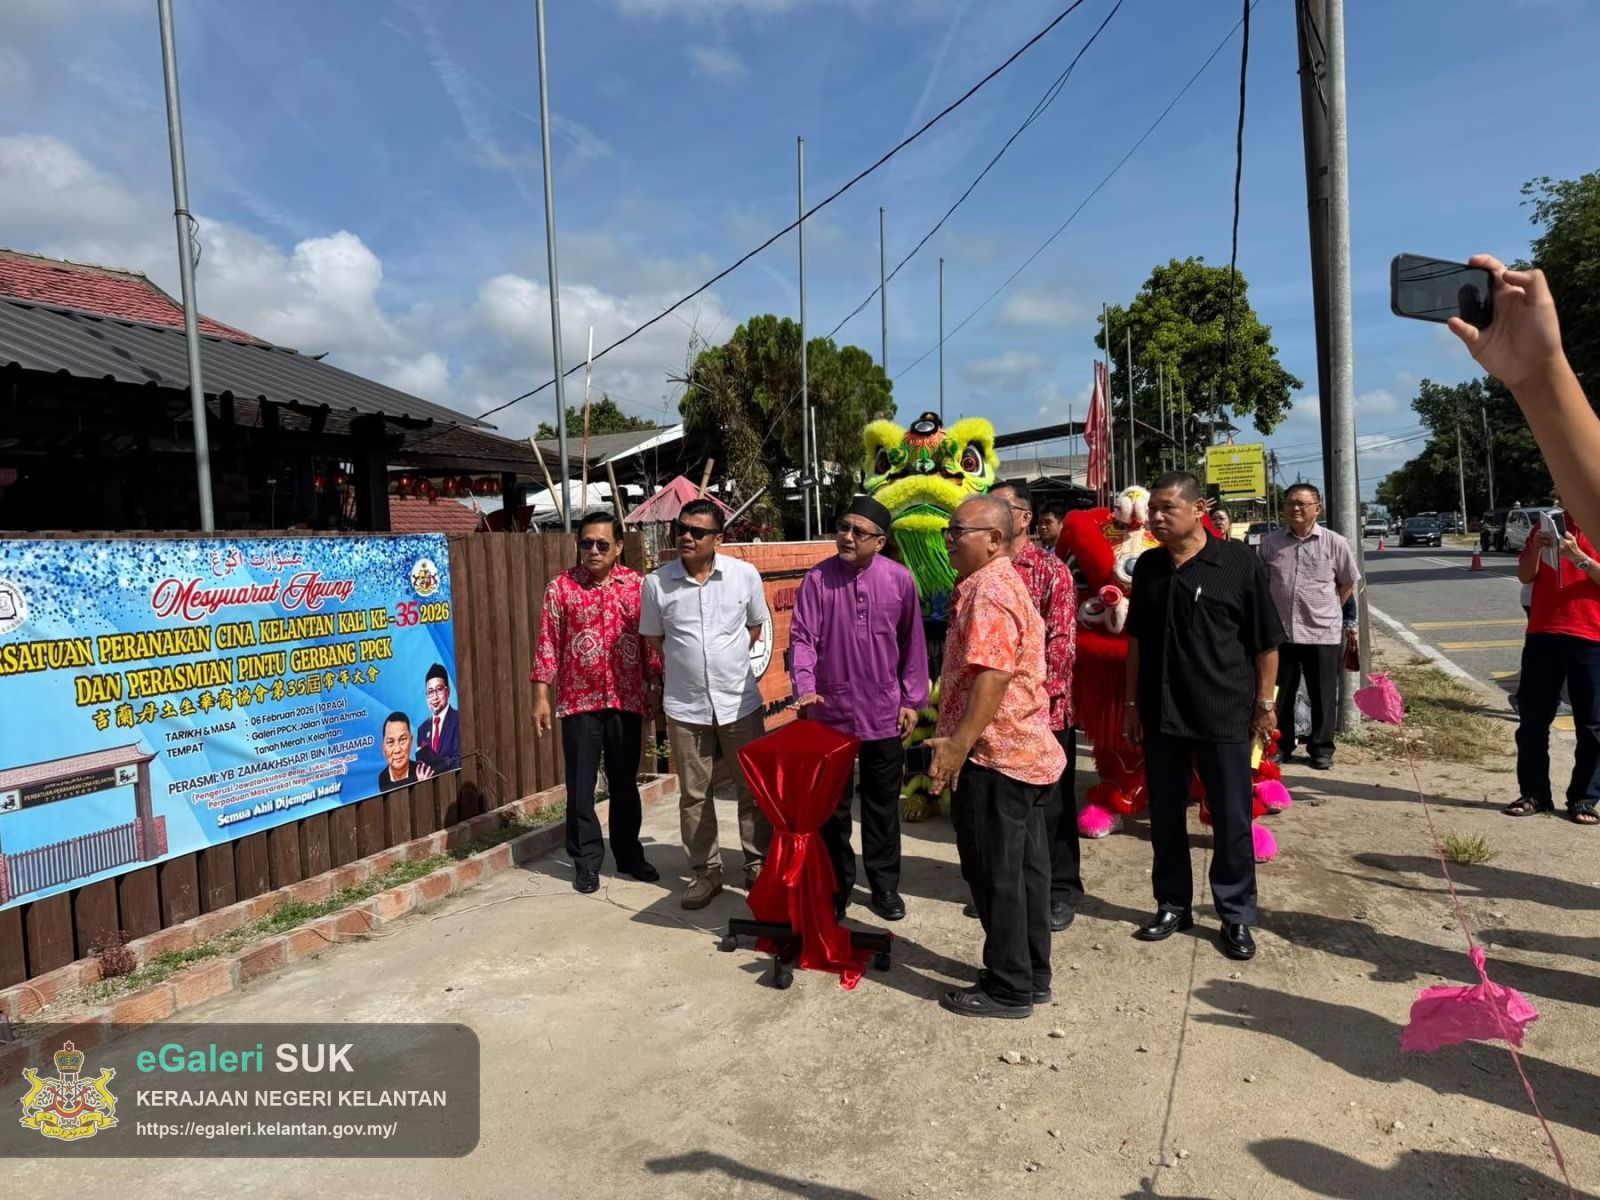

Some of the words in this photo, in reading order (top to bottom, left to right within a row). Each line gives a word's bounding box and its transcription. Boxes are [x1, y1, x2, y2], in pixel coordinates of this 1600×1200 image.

[152, 577, 280, 621] Mesyuarat
[281, 572, 354, 610] Agung
[97, 626, 212, 664] PERANAKAN
[216, 619, 256, 650] CINA
[259, 613, 334, 644] KELANTAN
[338, 609, 367, 634] KALI
[420, 601, 450, 625] 2026
[75, 672, 123, 707] DAN
[125, 658, 233, 699] PERASMIAN
[237, 651, 286, 681] PINTU
[290, 642, 356, 673] GERBANG
[359, 636, 392, 660] PPCK
[165, 728, 202, 742] TARIKH
[203, 727, 210, 736] &
[211, 721, 237, 734] MASA
[250, 716, 261, 726] 06
[262, 710, 296, 724] Februari
[296, 705, 315, 717] 2026
[166, 742, 205, 758] TEMPAT
[252, 729, 276, 741] Galeri
[321, 715, 339, 726] Wan
[254, 742, 280, 755] Tanah
[280, 736, 306, 750] Merah
[168, 773, 219, 795] PERASMI:
[220, 768, 235, 782] YB
[237, 752, 308, 777] ZAMAKHSHARI
[311, 748, 326, 760] BIN
[327, 735, 374, 755] MUHAMAD
[217, 808, 252, 827] Semua
[253, 802, 274, 816] Ahli
[275, 791, 317, 810] Dijemput
[317, 782, 342, 799] Hadir
